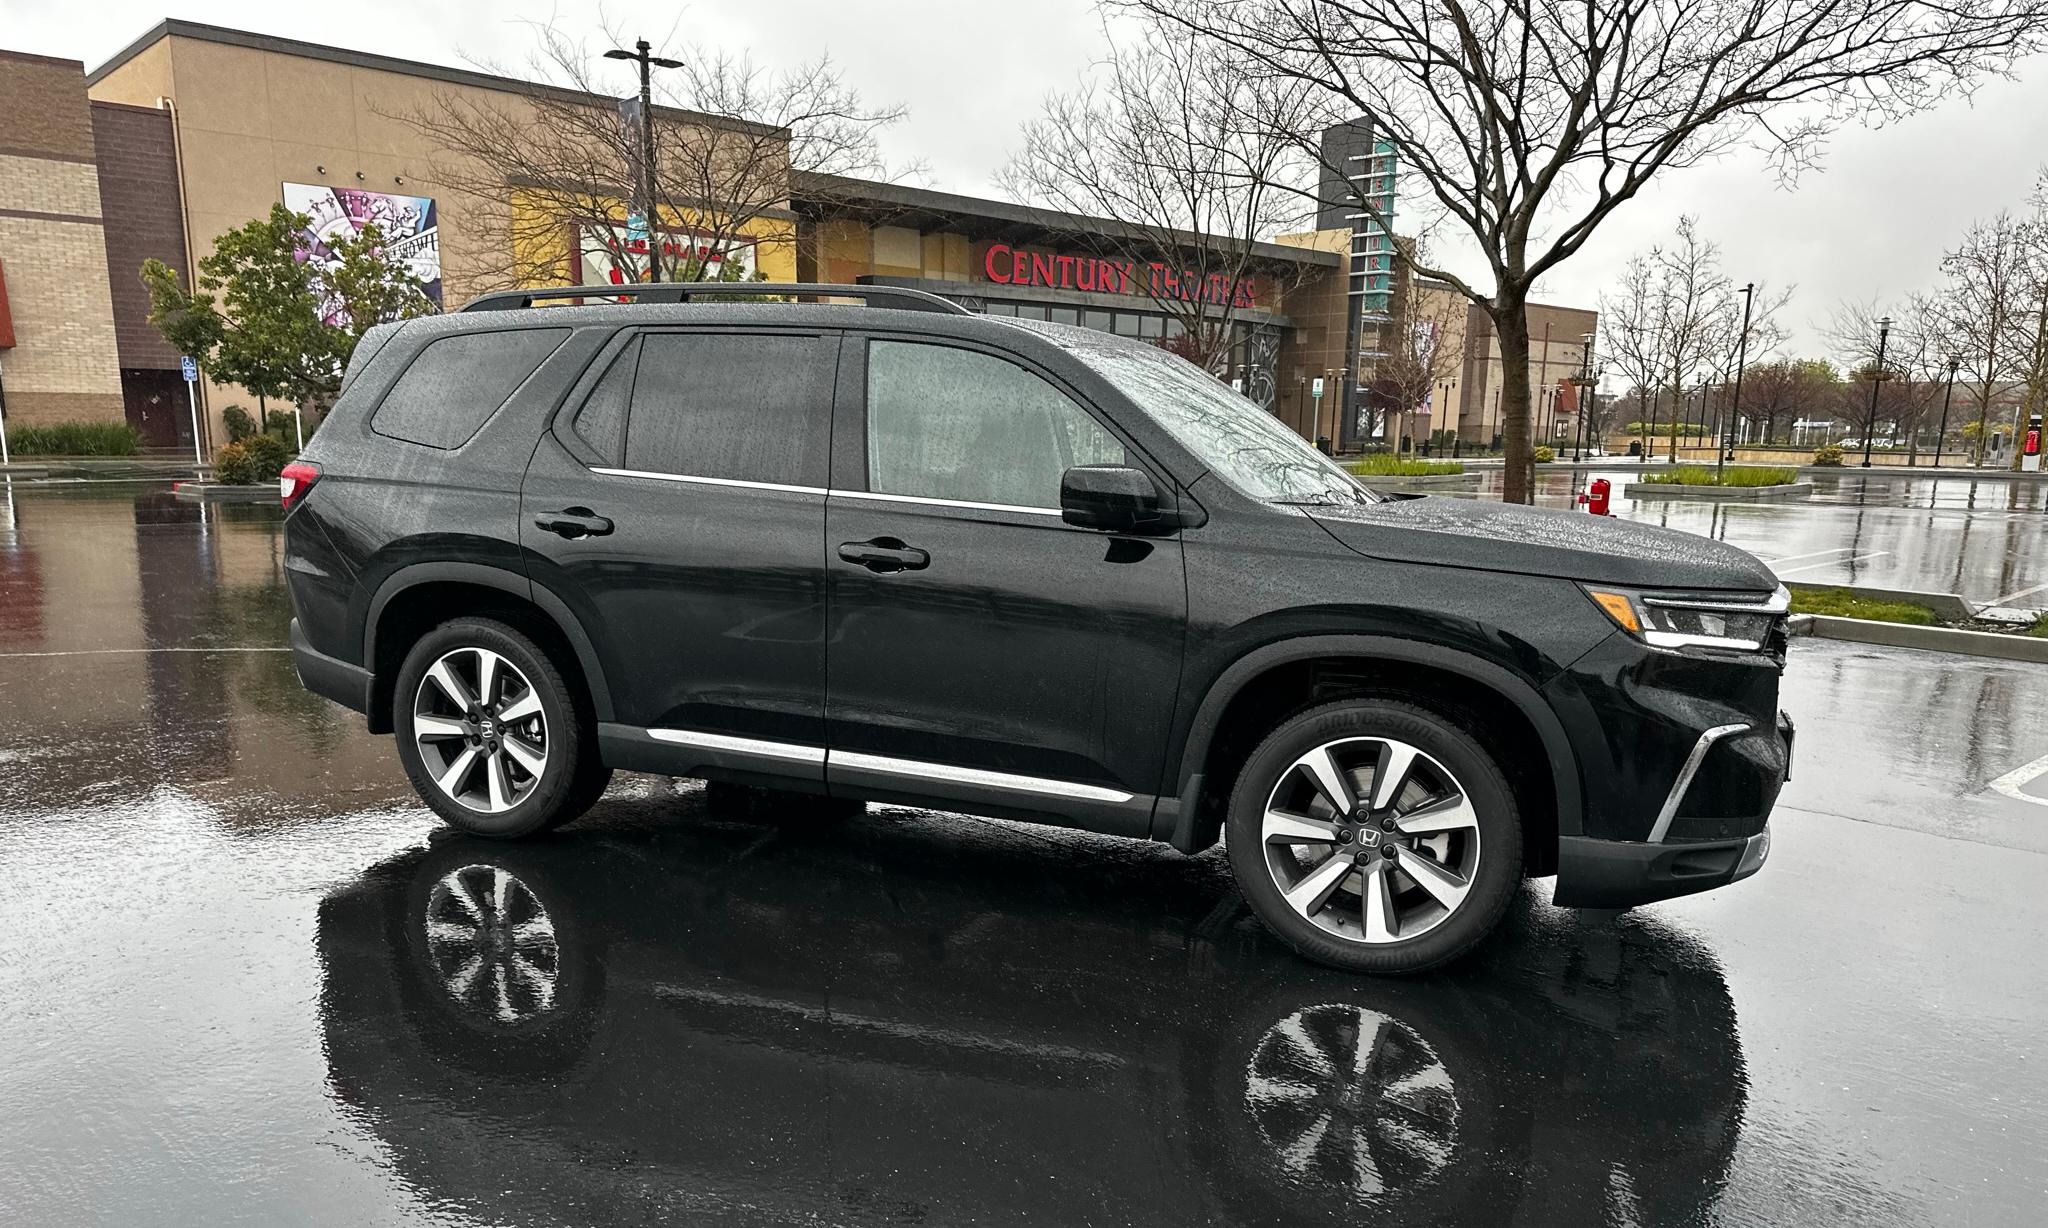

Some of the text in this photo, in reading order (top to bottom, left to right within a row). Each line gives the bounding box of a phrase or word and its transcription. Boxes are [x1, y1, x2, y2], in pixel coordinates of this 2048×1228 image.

[1367, 157, 1382, 287] ENURY
[985, 244, 1256, 308] CENTURY THEATRES
[1316, 711, 1442, 744] BRIDGESTONE
